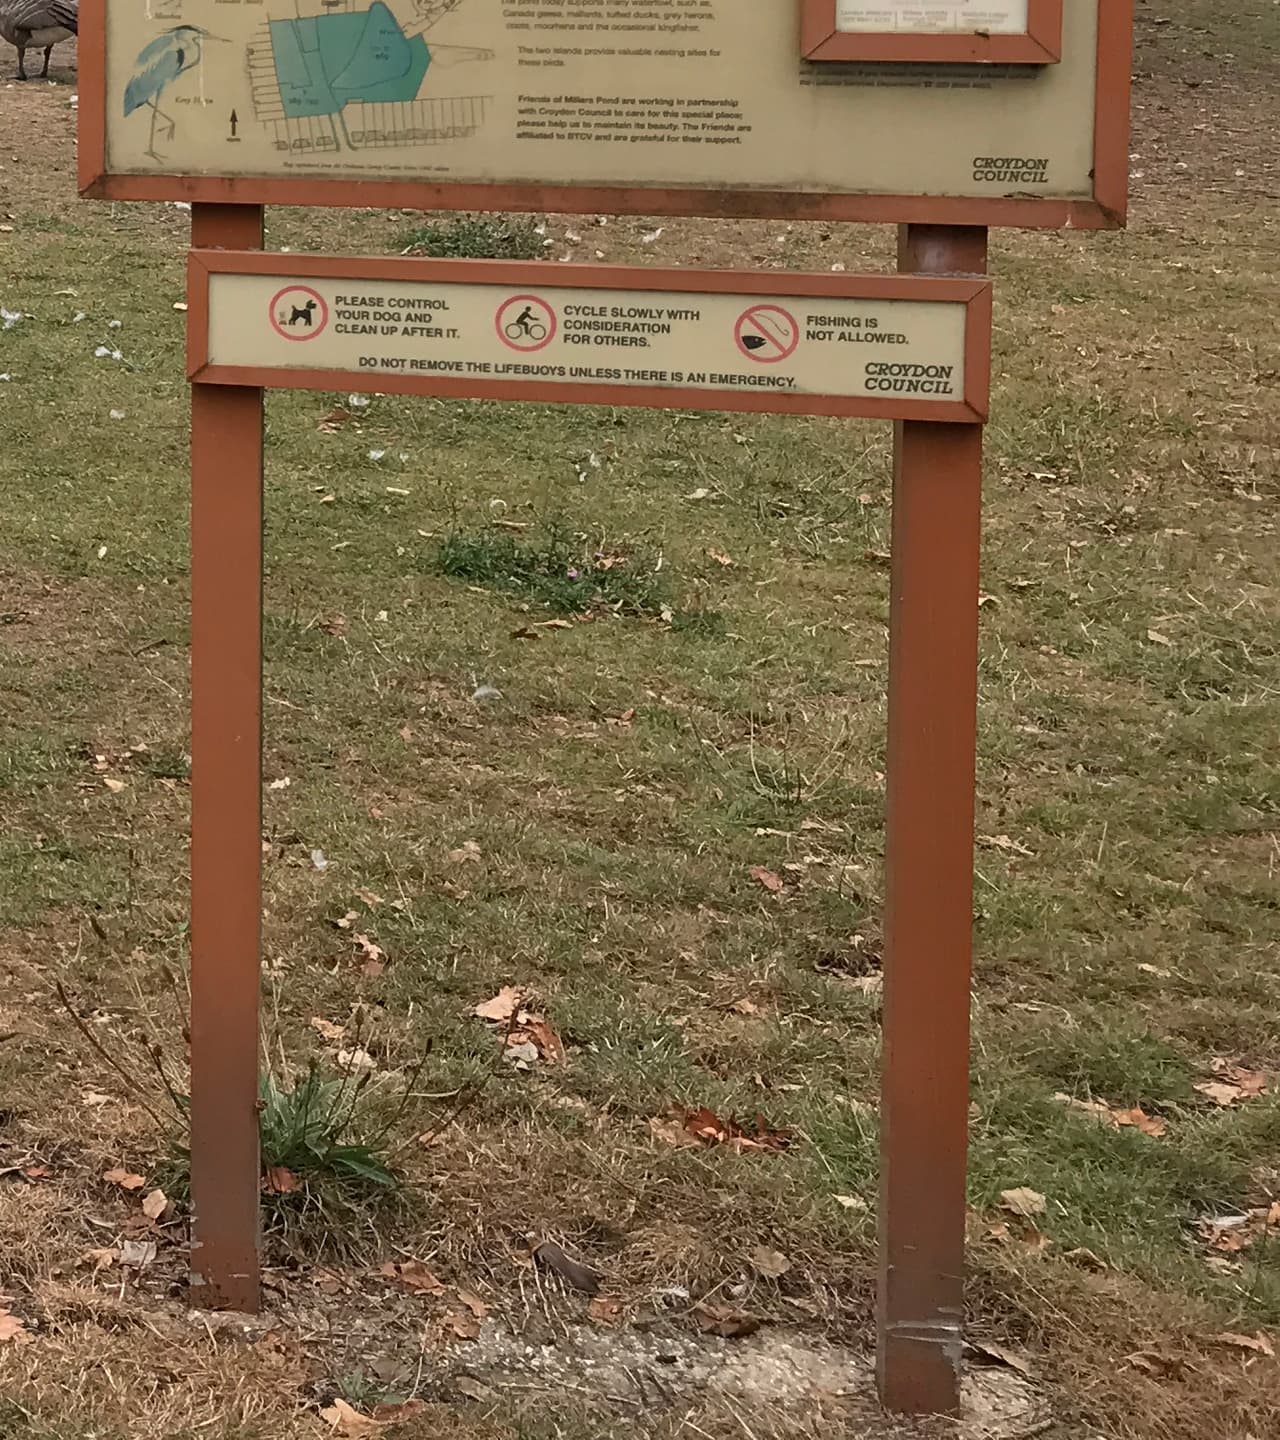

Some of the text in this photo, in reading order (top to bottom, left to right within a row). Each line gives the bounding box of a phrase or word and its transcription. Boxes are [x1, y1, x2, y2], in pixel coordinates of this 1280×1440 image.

[973, 157, 1049, 170] CROYDON
[973, 170, 1049, 183] COUNCIL
[335, 296, 450, 310] PLEASE CONTROL
[335, 310, 432, 324] YOUR DOG AND
[564, 305, 700, 321] CYCLE SLOWLY WITH
[564, 319, 671, 334] CONSIDERATION
[807, 315, 878, 328] FISHING IS
[335, 324, 461, 338] CLEAN UP AFTER IT.
[807, 331, 909, 345] NOT ALLOWED.
[564, 334, 651, 348] FOR OTHERS.
[359, 357, 797, 388] DO NOT REMOVE THE LIFEBUOYS UNLESS THERE IS AN EMERGENCY.
[865, 362, 953, 379] CROYDON
[864, 377, 953, 395] COUNCIL
